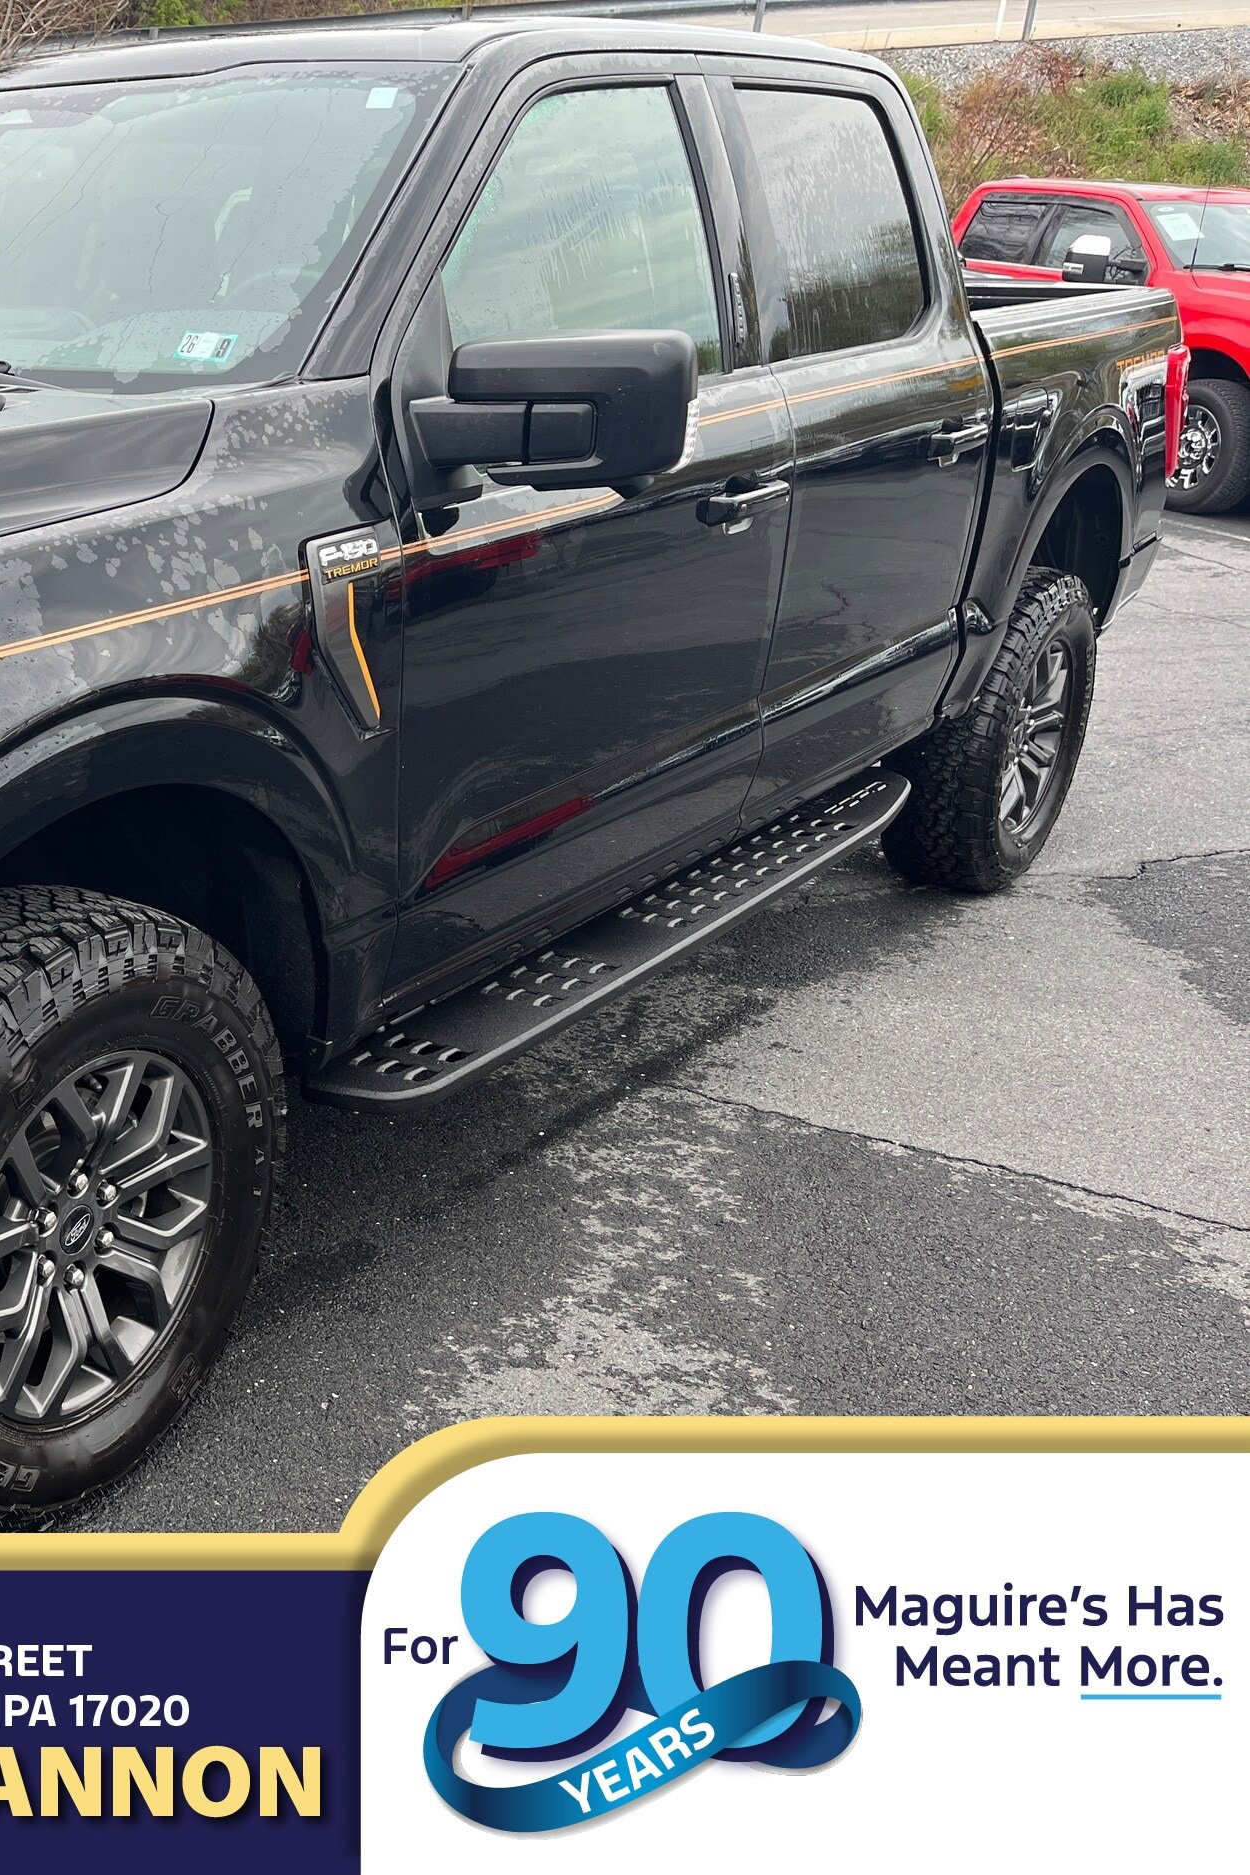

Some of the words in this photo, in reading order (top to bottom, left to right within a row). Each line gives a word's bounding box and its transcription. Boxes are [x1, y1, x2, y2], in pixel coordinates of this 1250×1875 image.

[180, 334, 199, 353] 26
[215, 338, 232, 358] 9
[319, 538, 377, 567] F-150
[324, 557, 378, 579] TREMOR
[150, 996, 264, 1128] GRABBER
